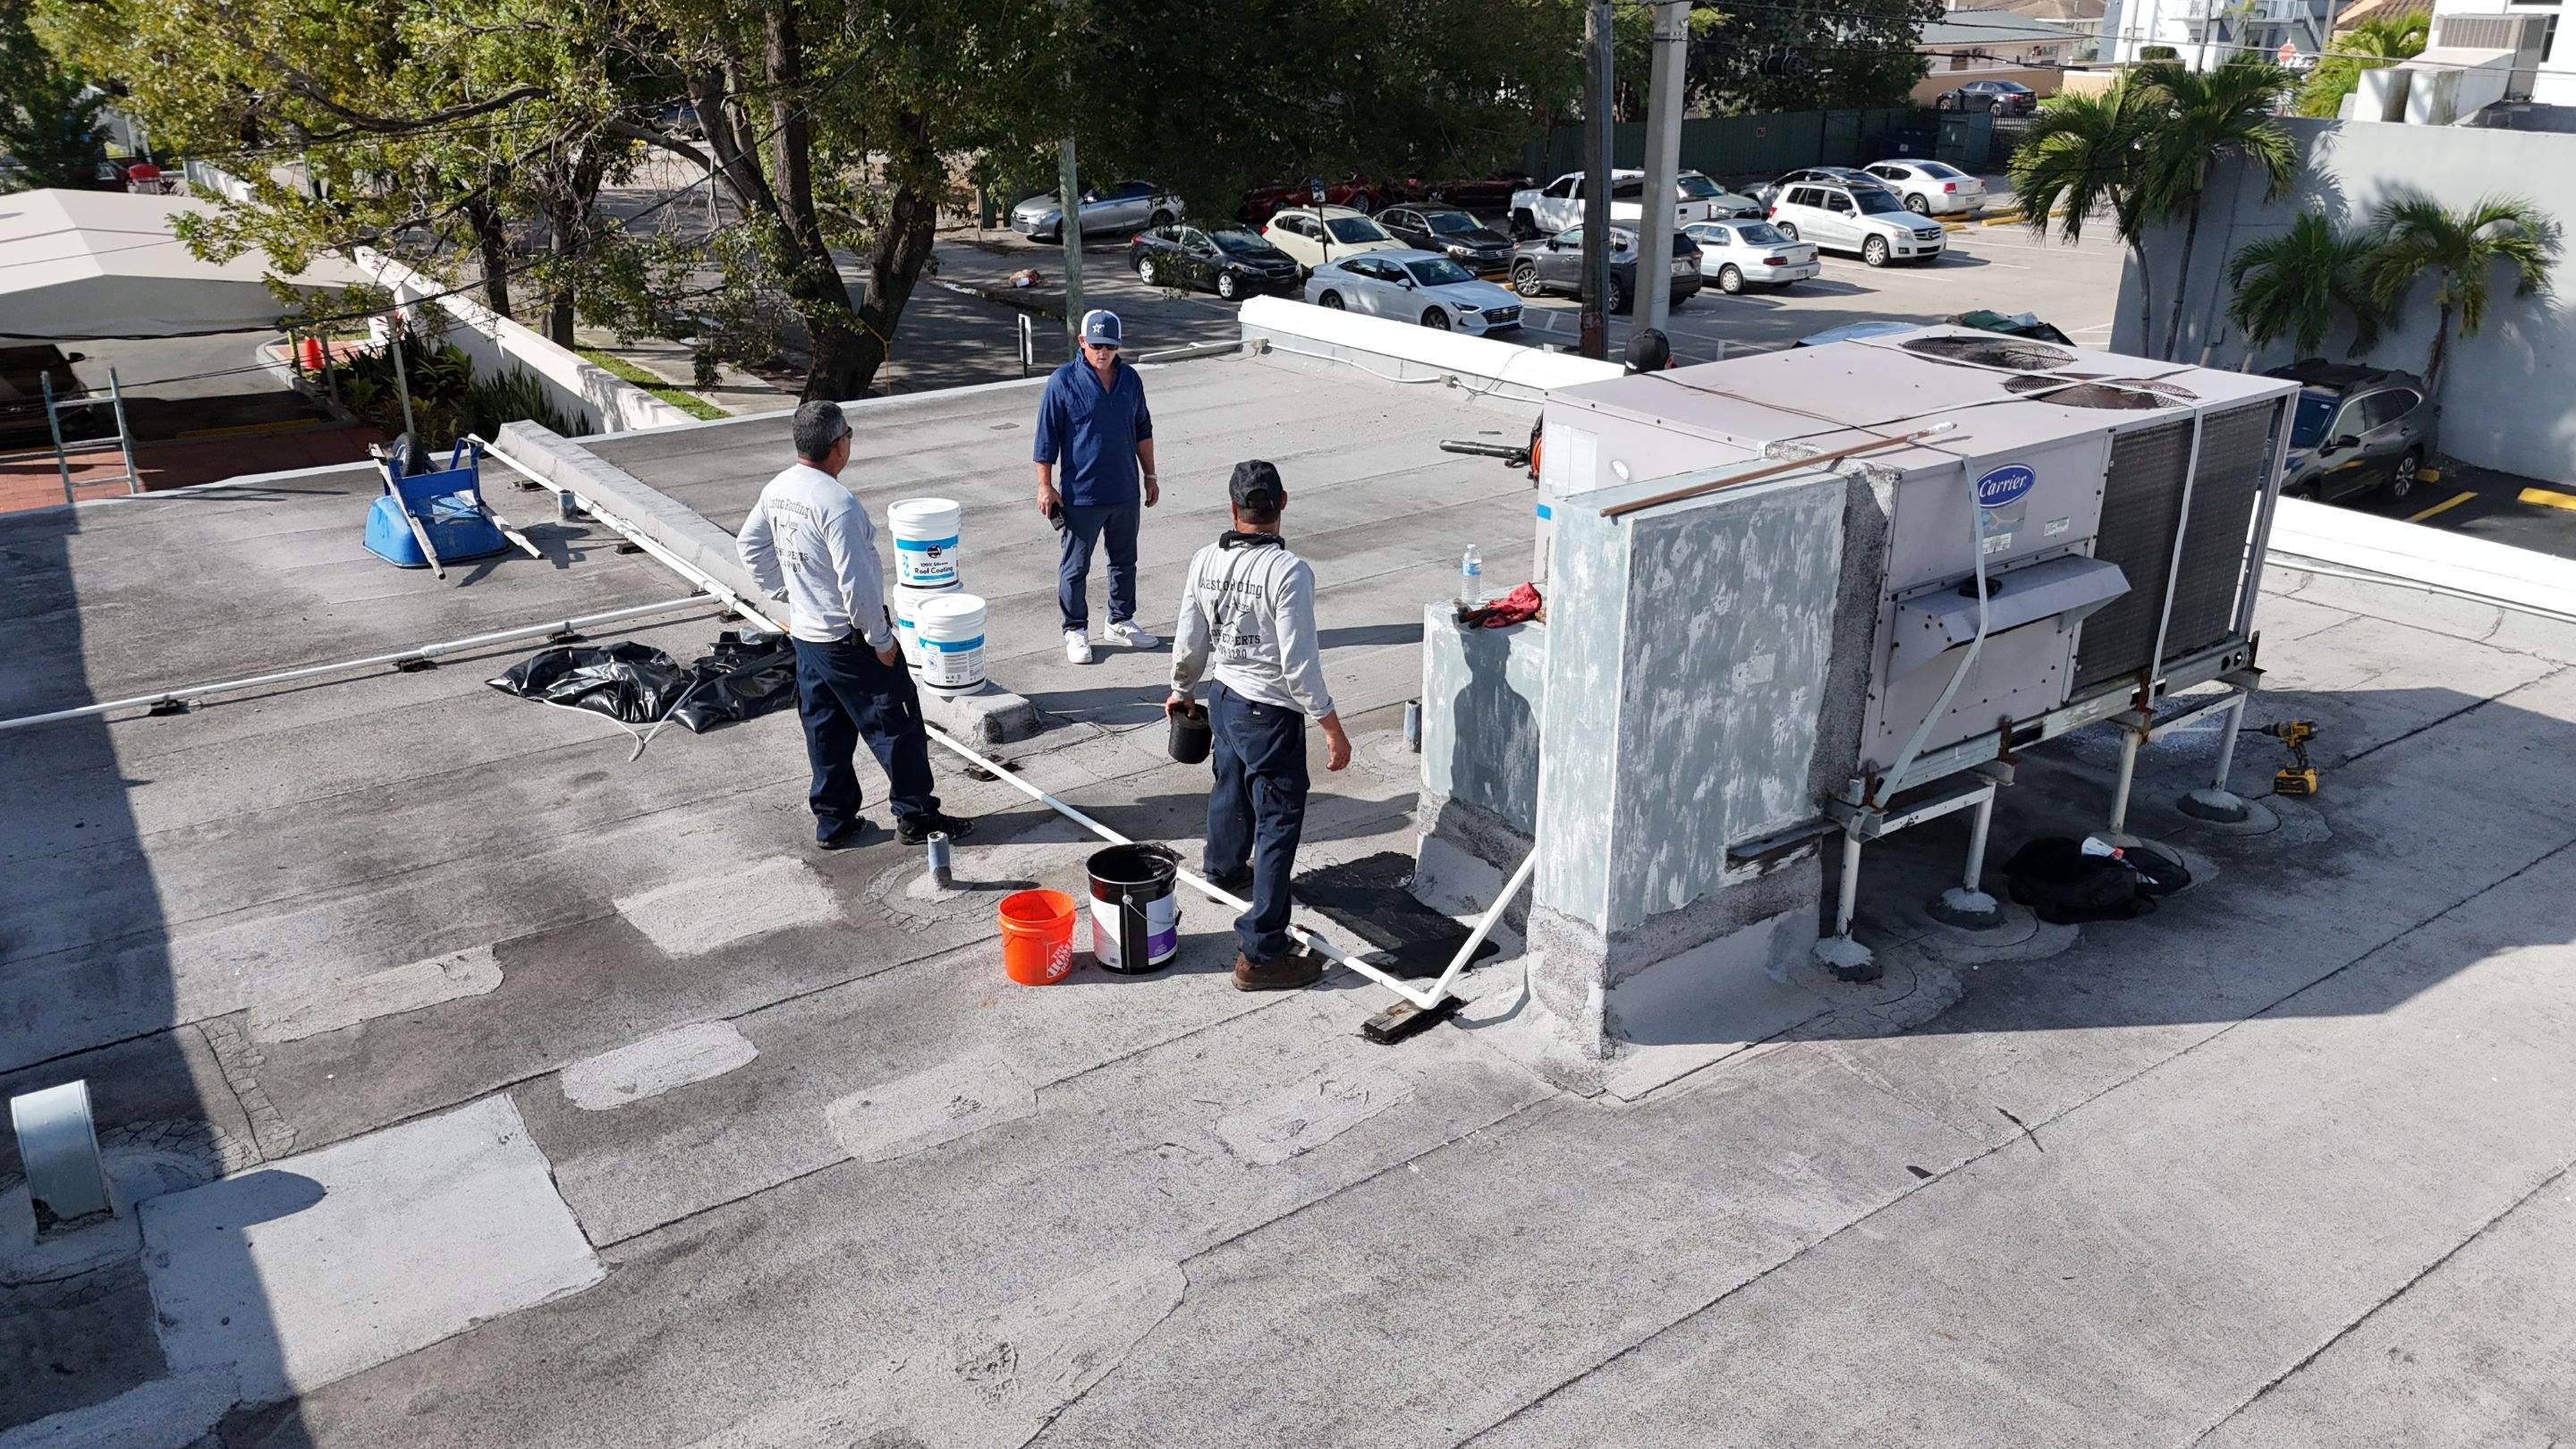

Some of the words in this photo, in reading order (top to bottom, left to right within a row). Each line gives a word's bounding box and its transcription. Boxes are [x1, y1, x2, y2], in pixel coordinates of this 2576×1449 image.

[1979, 475, 2027, 498] Carrier
[930, 566, 953, 574] Coating
[1222, 633, 1261, 646] EXPERTS
